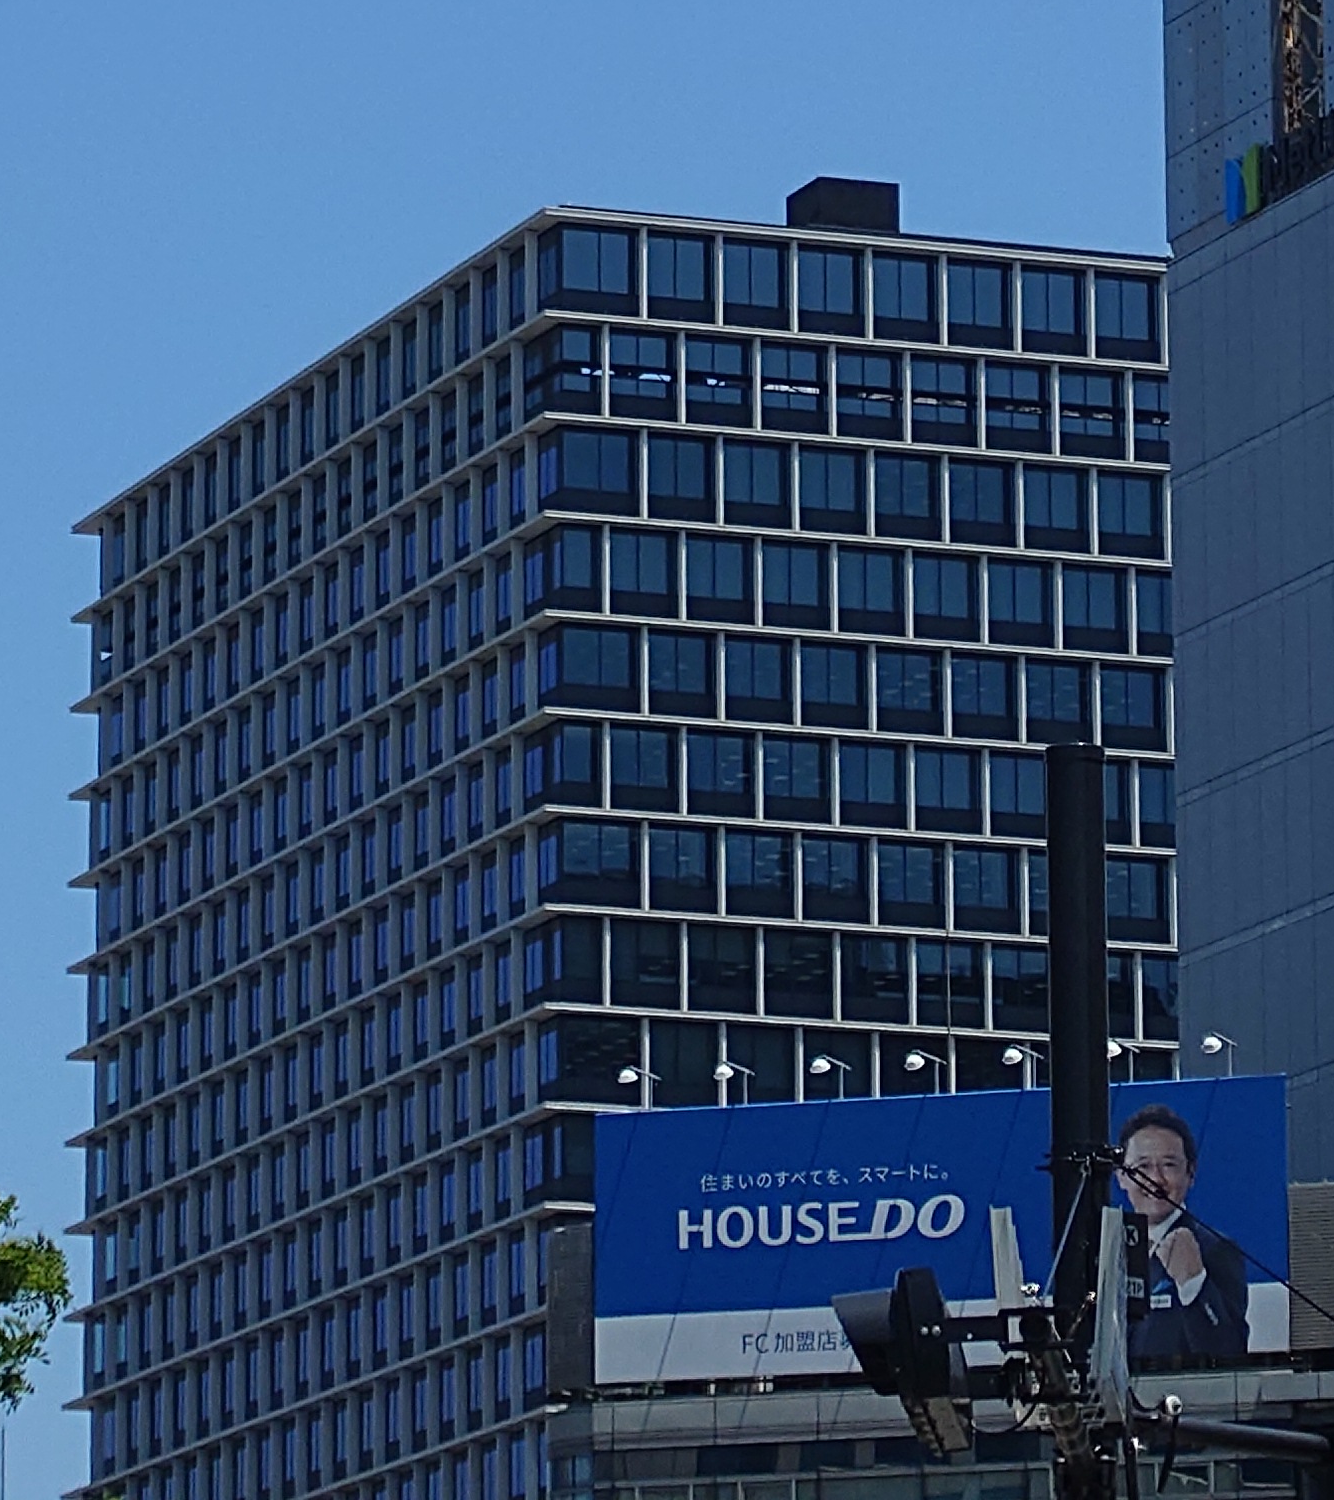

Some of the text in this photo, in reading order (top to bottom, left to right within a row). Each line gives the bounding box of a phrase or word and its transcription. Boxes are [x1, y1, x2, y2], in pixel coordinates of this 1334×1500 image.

[700, 1163, 949, 1193] 住まいのすべてを、スマートに。
